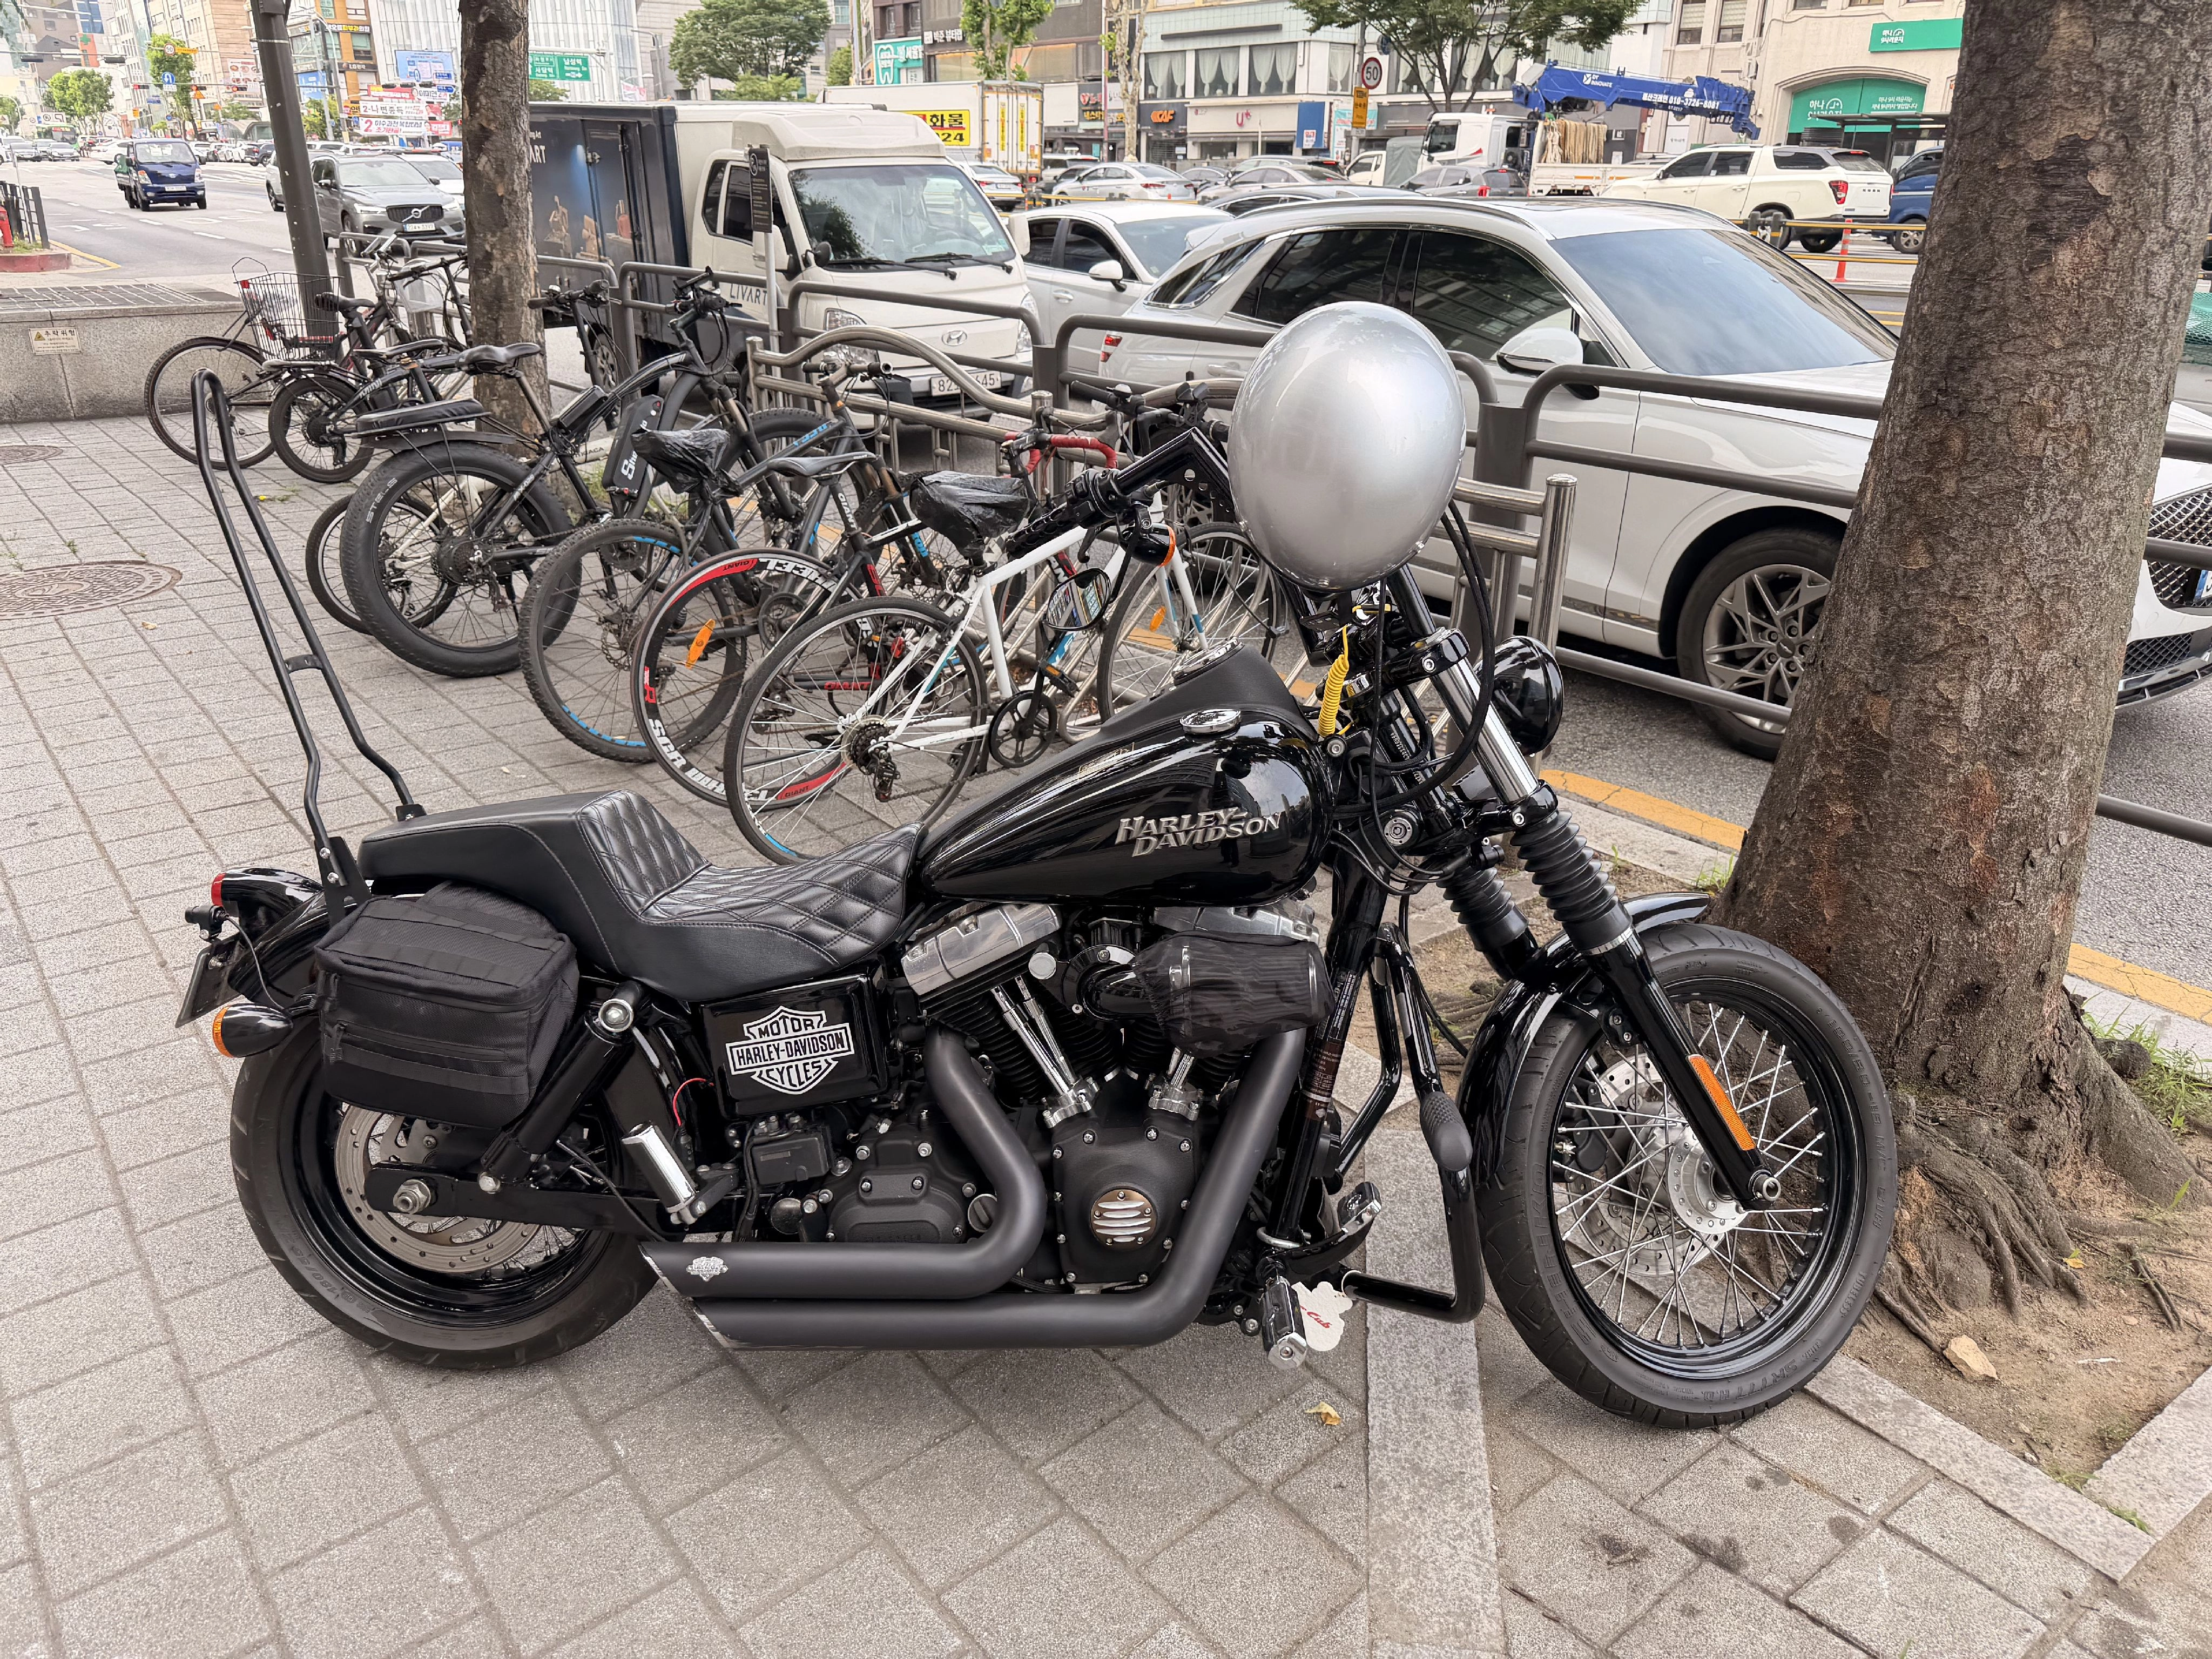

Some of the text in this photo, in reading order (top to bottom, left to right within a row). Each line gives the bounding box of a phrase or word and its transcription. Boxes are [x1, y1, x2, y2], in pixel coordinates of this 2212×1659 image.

[1366, 66, 1378, 80] 50
[1810, 100, 1824, 110] 하나
[364, 119, 373, 132] 2
[930, 113, 963, 127] 화물
[938, 132, 964, 142] 24
[731, 283, 766, 306] LIVART
[366, 477, 398, 523] STELS
[837, 493, 858, 529] GIANT
[723, 560, 749, 571] GIANT
[649, 718, 687, 770] SCR
[785, 786, 809, 797] GIANT
[1132, 812, 1280, 857] DAVIDSON
[758, 1015, 815, 1038] MOTOR
[737, 1030, 845, 1066] HARLEY-DAVIDSON
[766, 1059, 822, 1088] CYCLES
